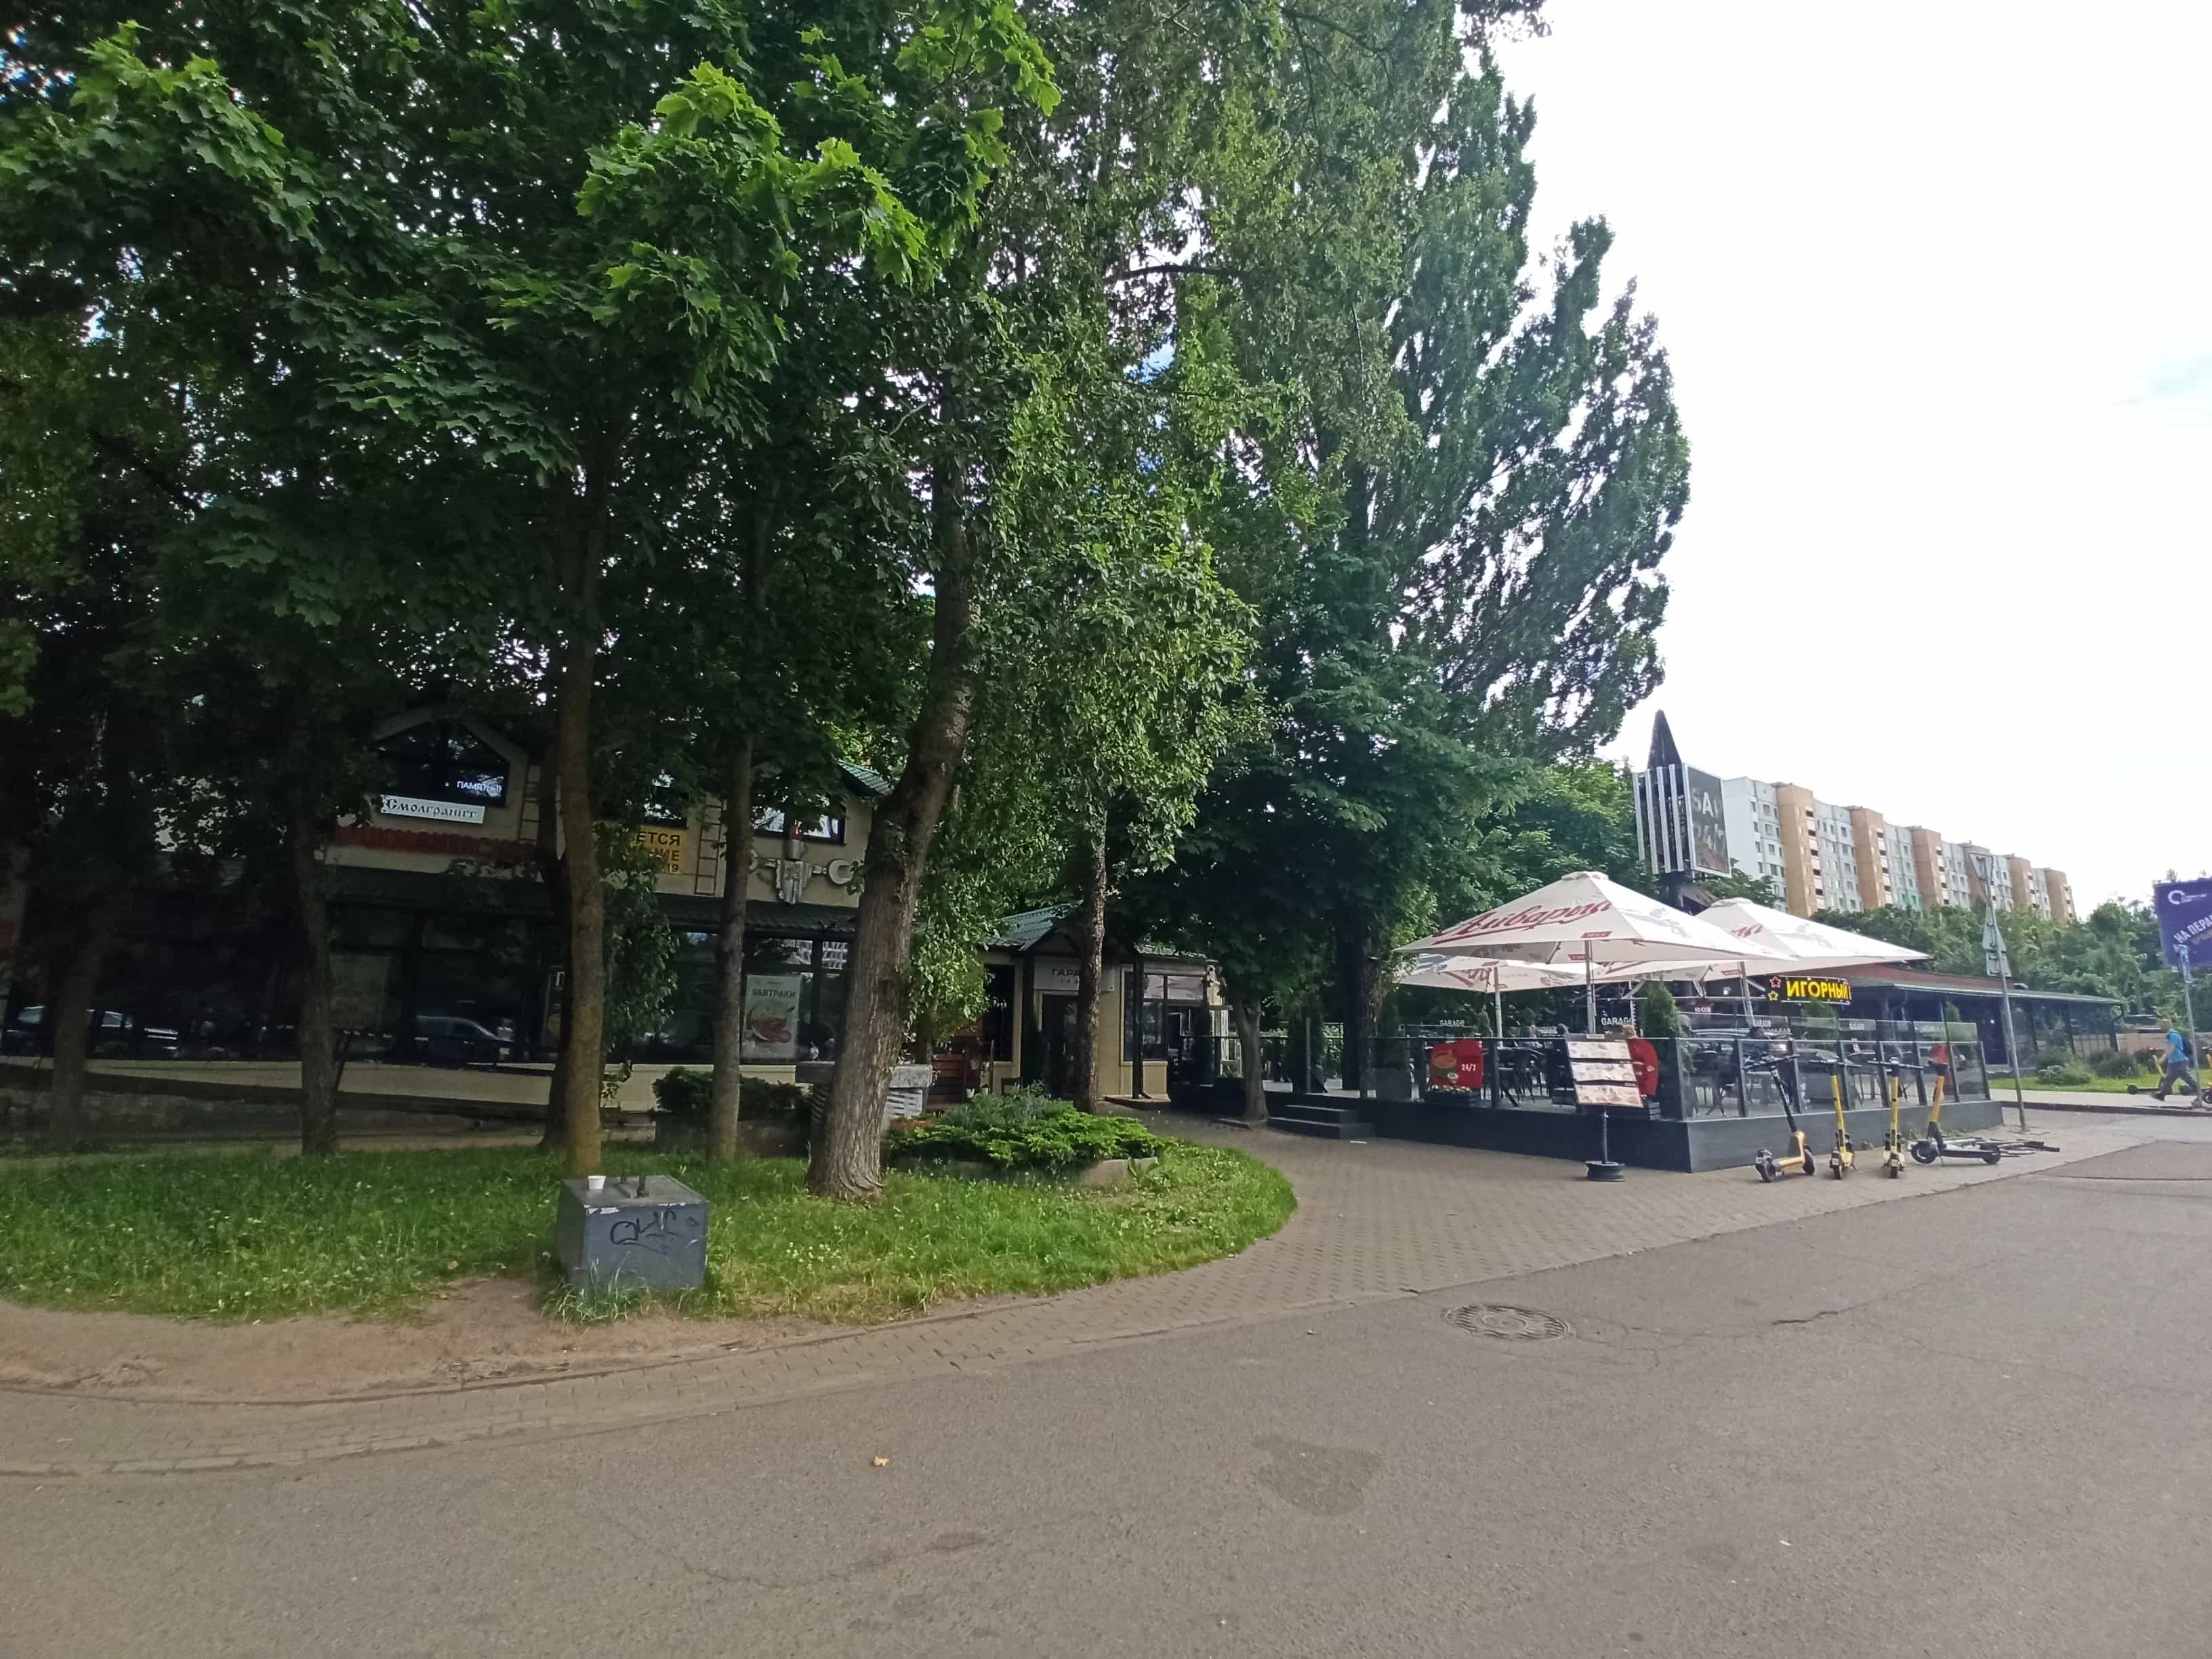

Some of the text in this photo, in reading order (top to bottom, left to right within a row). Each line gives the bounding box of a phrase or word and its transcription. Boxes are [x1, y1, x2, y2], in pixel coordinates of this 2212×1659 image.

[2173, 930, 2191, 943] НА
[752, 989, 796, 998] ЗАВТРАКИ
[1786, 981, 1849, 1000] ИГОРНЫЙ
[1601, 1017, 1633, 1025] GARAG
[1461, 1063, 1476, 1072] 24/7
